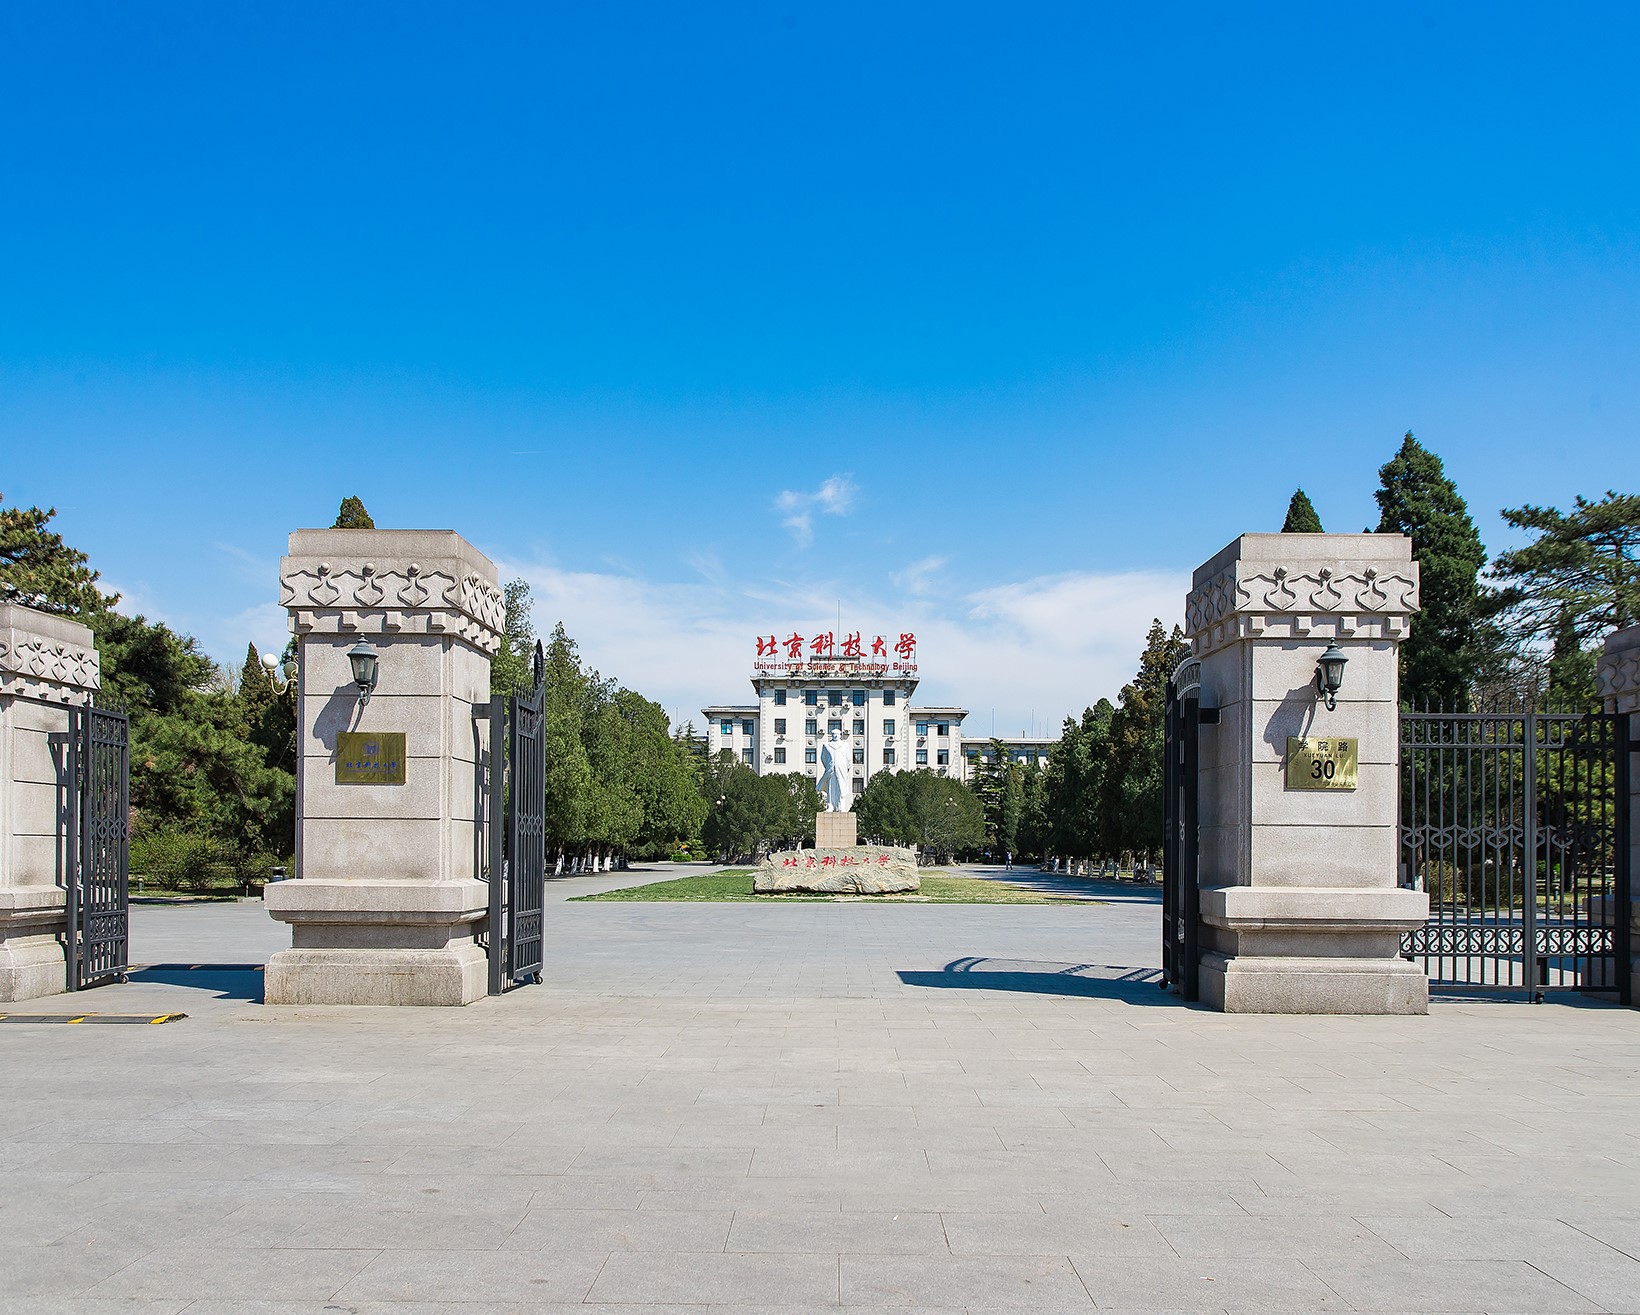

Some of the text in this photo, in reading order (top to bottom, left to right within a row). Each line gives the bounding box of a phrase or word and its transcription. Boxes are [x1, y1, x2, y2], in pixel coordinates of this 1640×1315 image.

[756, 631, 917, 660] 北京科技大学
[754, 662, 918, 672] University of Science & Technology Beijing
[1298, 739, 1348, 751] 学院路
[1311, 760, 1335, 779] 30
[783, 854, 890, 869] 北京科技大学
